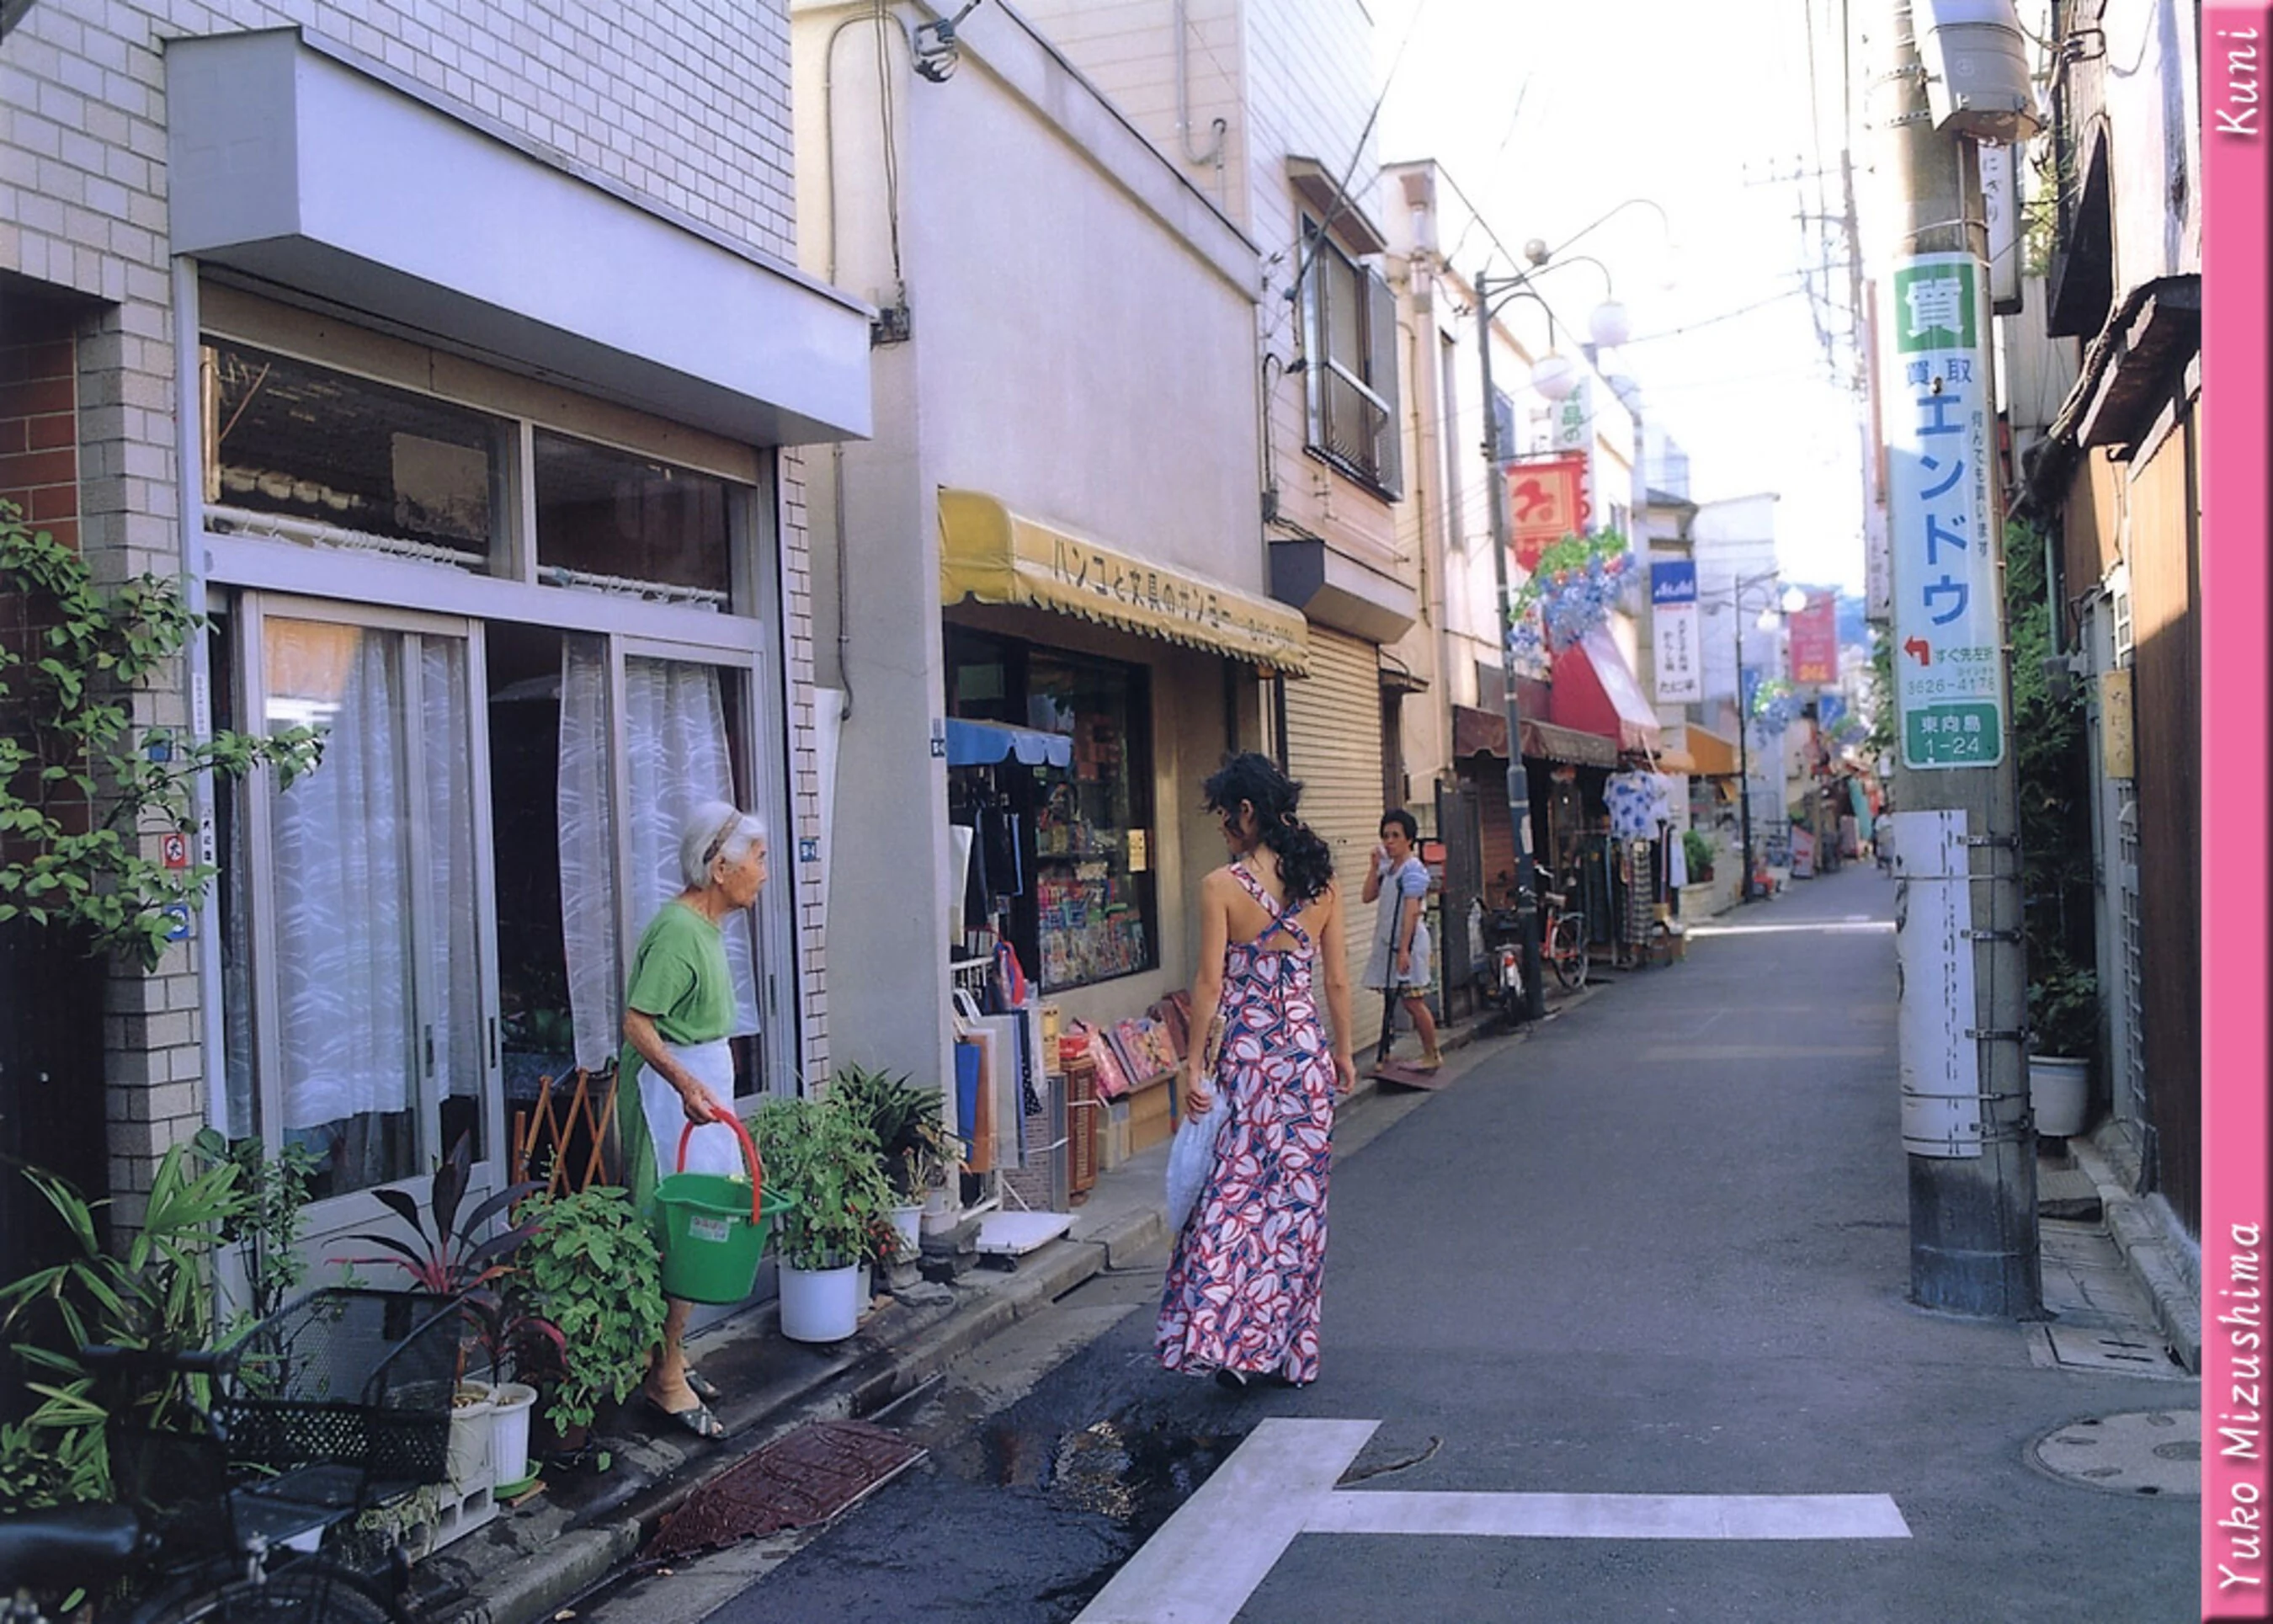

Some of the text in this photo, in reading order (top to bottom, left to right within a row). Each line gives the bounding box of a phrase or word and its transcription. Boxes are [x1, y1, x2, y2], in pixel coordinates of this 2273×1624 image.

[1905, 277, 1963, 338] 質
[1906, 358, 1972, 386] 買取
[1916, 394, 1969, 626] エンドウ
[1921, 716, 1981, 734] 東向島
[1924, 737, 1979, 755] 1-24
